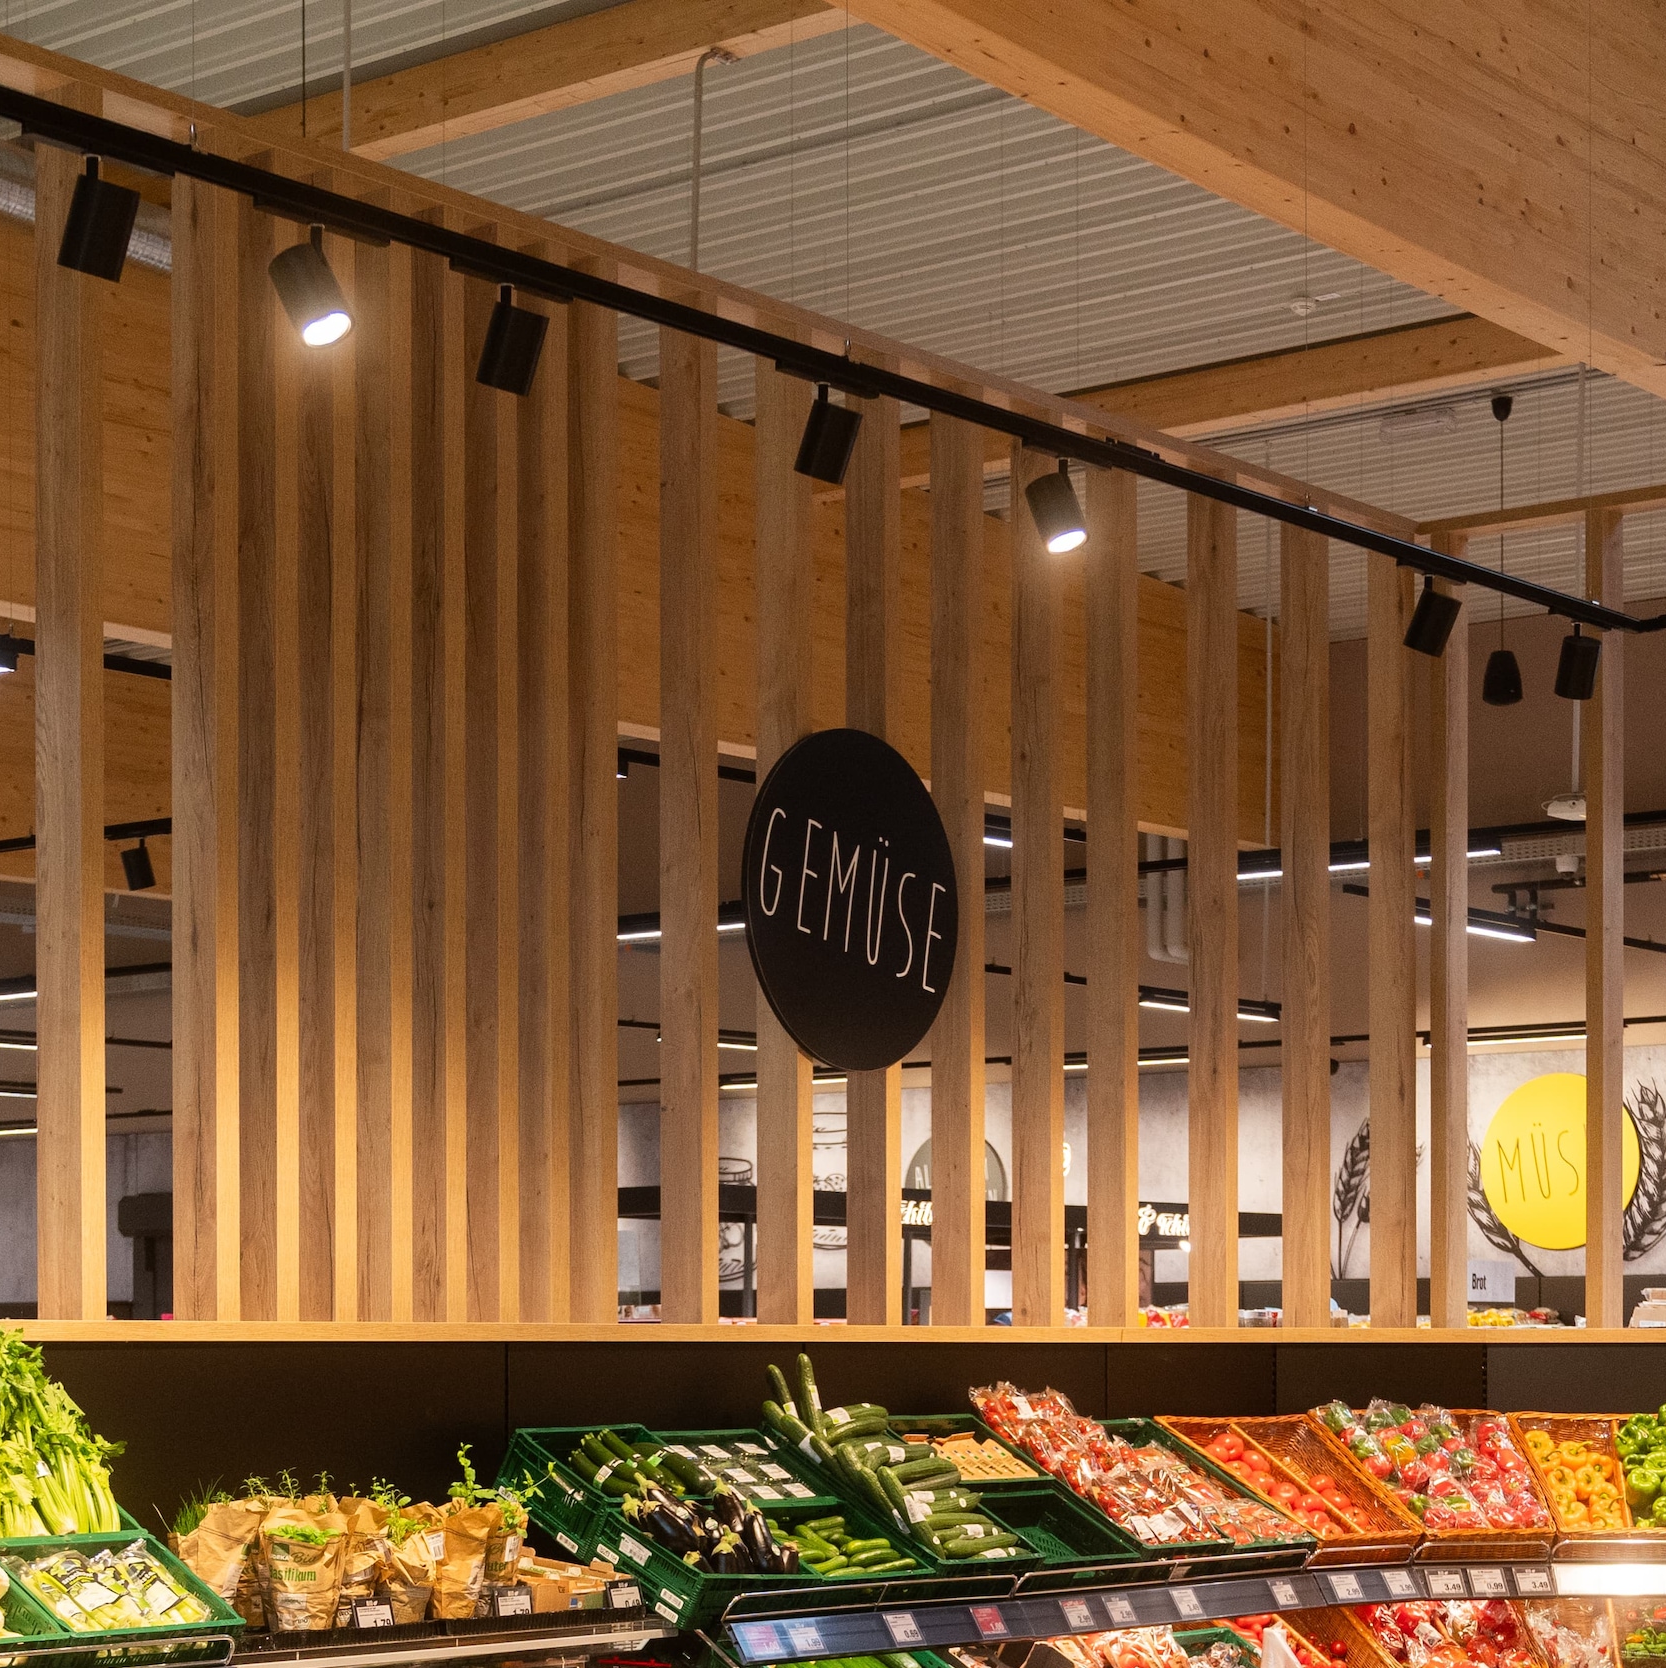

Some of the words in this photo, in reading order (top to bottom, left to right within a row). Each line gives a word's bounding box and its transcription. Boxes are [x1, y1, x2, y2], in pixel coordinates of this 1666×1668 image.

[760, 807, 946, 993] GEMÜSE
[1496, 1123, 1586, 1204] MÜS
[1471, 1273, 1487, 1291] Brot
[1444, 1583, 1461, 1591] 3.49
